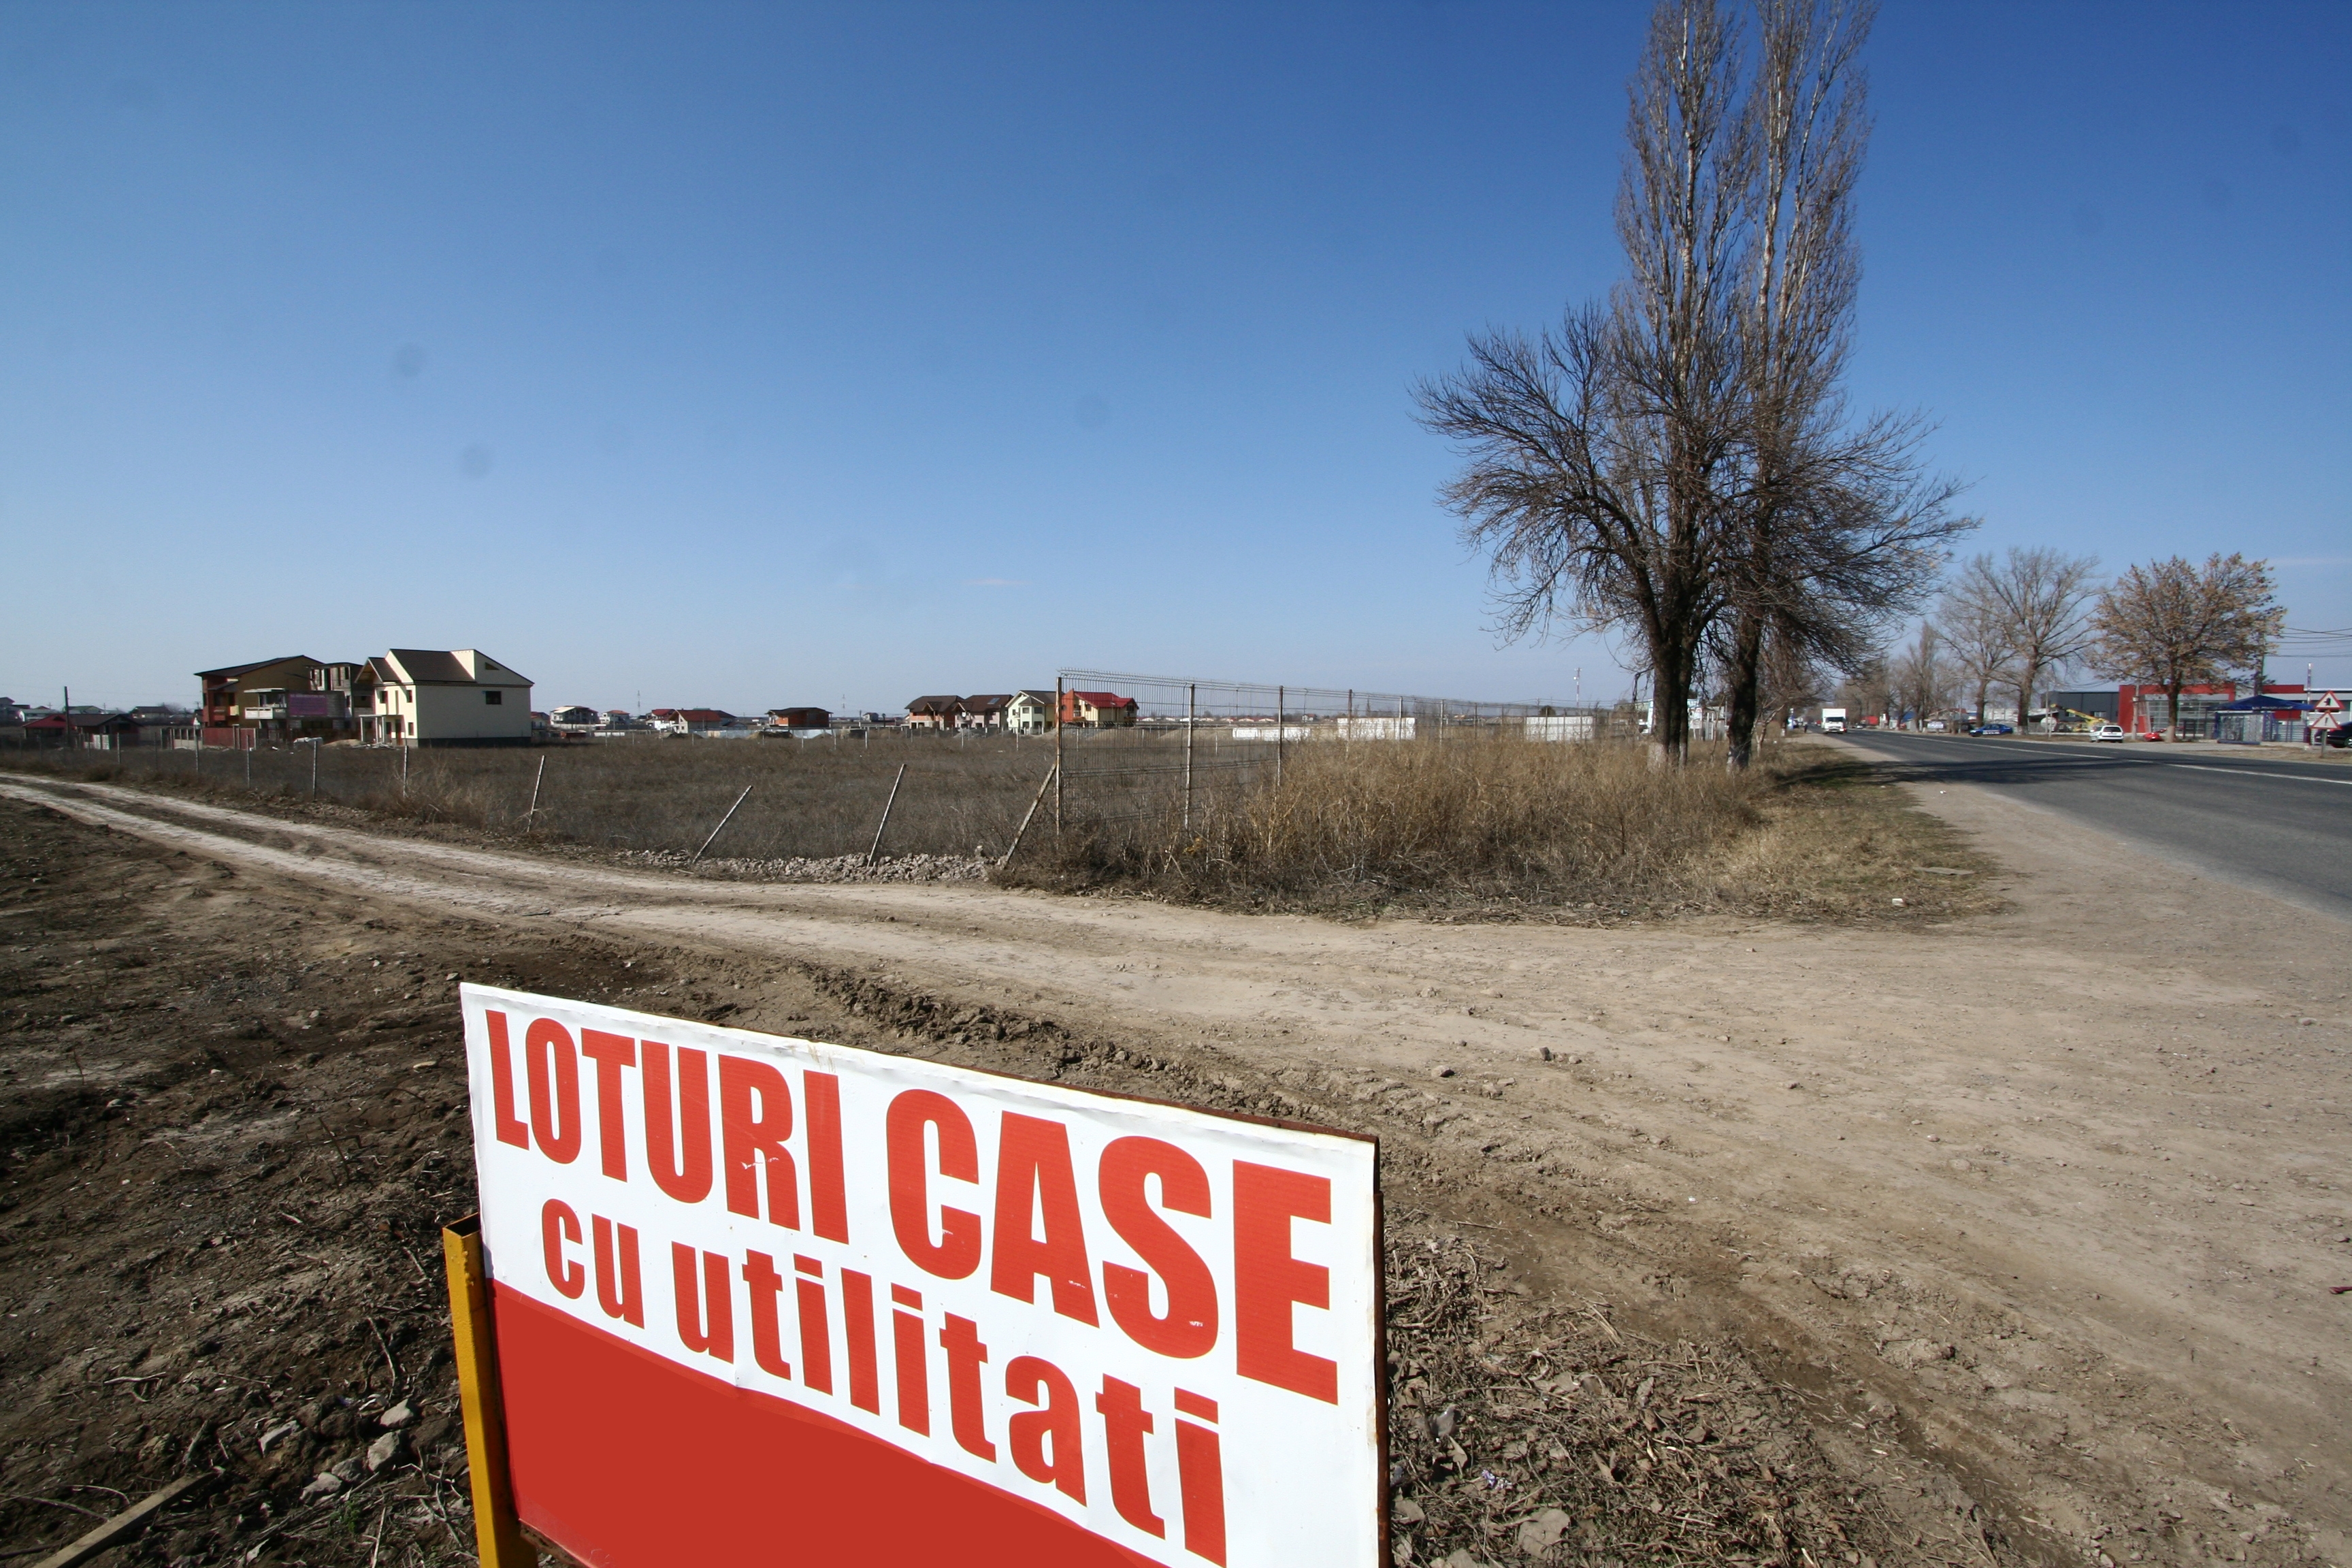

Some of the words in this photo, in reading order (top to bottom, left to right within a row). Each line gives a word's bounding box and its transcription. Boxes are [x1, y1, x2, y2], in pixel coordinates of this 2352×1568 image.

[486, 1009, 850, 1245] LOTURI
[886, 1088, 1339, 1405] CASE
[542, 1198, 645, 1329] cu
[672, 1241, 1227, 1568] utilitati
